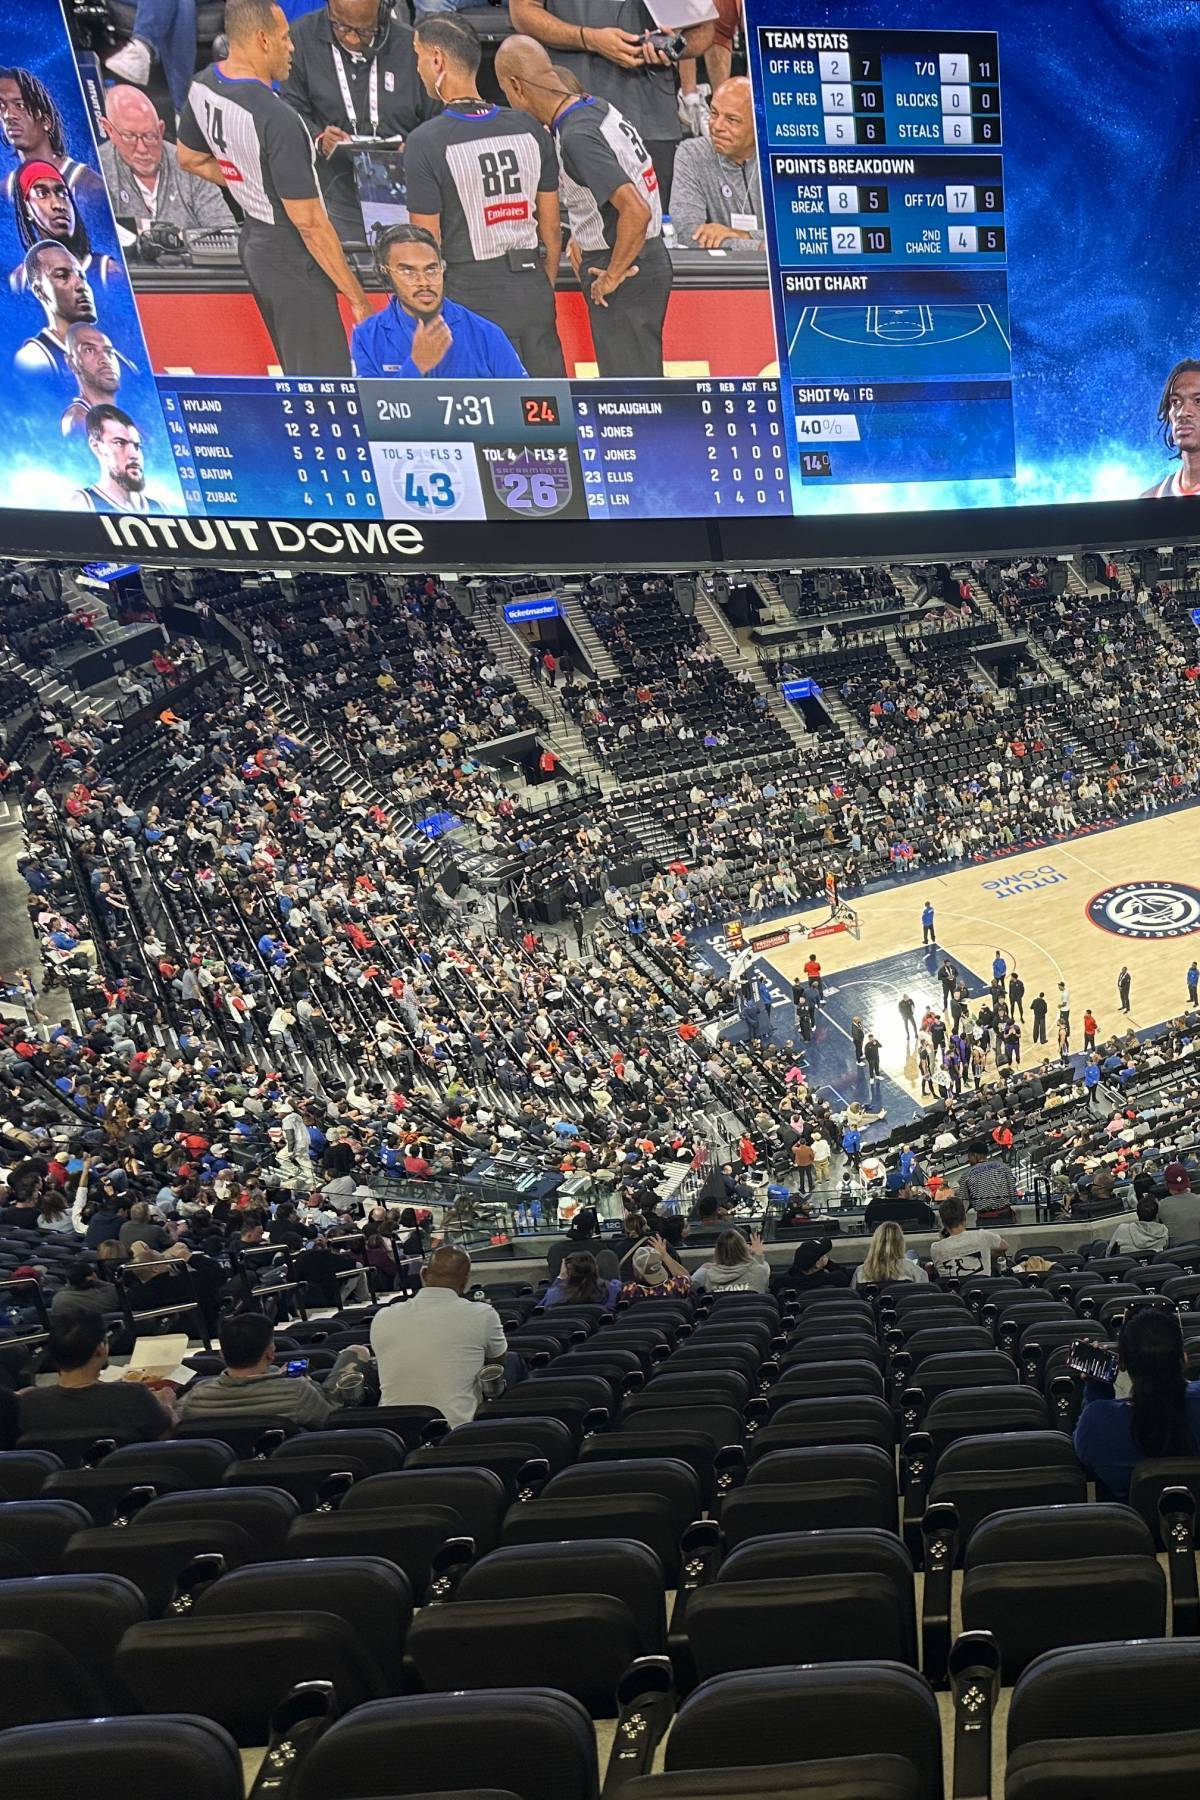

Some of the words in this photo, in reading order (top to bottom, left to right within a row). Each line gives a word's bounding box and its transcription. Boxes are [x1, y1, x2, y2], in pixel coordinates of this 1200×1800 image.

[765, 32, 804, 48] TEAM
[807, 34, 848, 49] STATS
[770, 60, 790, 74] OFF
[794, 60, 814, 75] REB
[831, 61, 839, 75] 2
[862, 61, 870, 75] 7
[915, 62, 935, 76] T/O
[950, 62, 958, 76] 7
[979, 63, 990, 77] 11
[772, 92, 793, 105] DEF
[797, 92, 817, 105] REB
[830, 93, 844, 107] 12
[861, 93, 875, 107] 10
[896, 94, 938, 107] BLOCKS
[952, 94, 959, 108] 0
[982, 94, 990, 108] 0
[776, 124, 819, 137] ASSISTS
[836, 124, 844, 138] 5
[866, 124, 875, 139] 6
[899, 125, 939, 138] STEALS
[954, 125, 961, 138] 6
[983, 124, 992, 139] 6
[478, 150, 522, 197] 82
[776, 160, 825, 173] POINTS
[829, 160, 914, 174] BREAKDOWN
[798, 186, 822, 198] FAST
[839, 192, 848, 208] 8
[869, 192, 878, 209] 5
[905, 194, 925, 207] OFF
[925, 195, 944, 207] T/O
[953, 192, 967, 208] 17
[985, 192, 995, 209] 9
[488, 206, 524, 220] Emirates
[792, 202, 824, 214] BREAK
[796, 228, 807, 240] IN
[811, 228, 827, 240] THE
[837, 233, 855, 249] 22
[867, 233, 884, 249] 10
[923, 231, 941, 241] 2ND
[959, 232, 967, 248] 4
[987, 232, 996, 248] 5
[800, 242, 828, 255] PAINT
[906, 242, 941, 253] CHANCE
[786, 276, 821, 290] SHOT
[824, 276, 868, 290] CHART
[276, 382, 290, 392] PTS
[298, 383, 313, 392] REB
[321, 383, 334, 393] AST
[341, 384, 355, 393] FLS
[697, 383, 711, 393] PTS
[720, 383, 734, 392] REB
[742, 382, 756, 392] AST
[763, 382, 777, 391] FLS
[799, 389, 831, 402] SHOT
[833, 389, 849, 402] %
[859, 388, 873, 400] FG
[166, 399, 175, 411] 5
[184, 400, 221, 412] HYLAND
[282, 401, 293, 413] 2
[305, 401, 314, 414] 3
[328, 401, 335, 414] 1
[347, 401, 357, 414] 0
[377, 400, 411, 421] 2ND
[437, 396, 495, 426] 7:31
[525, 401, 554, 422] 24
[578, 403, 587, 415] 3
[598, 403, 662, 415] MCLAUGHLIN
[169, 422, 182, 433] 14
[189, 423, 218, 434] MANN
[285, 424, 300, 436] 12
[310, 424, 320, 436] 2
[332, 424, 341, 437] 0
[353, 424, 360, 437] 1
[579, 426, 593, 438] 15
[601, 427, 633, 438] JONES
[801, 420, 842, 434] 40%
[174, 445, 189, 456] 24
[195, 447, 233, 458] POWELL
[293, 447, 302, 459] 5
[315, 447, 325, 460] 2
[337, 448, 346, 460] 0
[357, 448, 366, 460] 2
[382, 449, 402, 459] TOL
[406, 450, 414, 460] 5
[431, 449, 450, 460] FLS
[455, 450, 462, 460] 3
[482, 449, 502, 461] TOL
[507, 448, 516, 460] 4
[534, 449, 555, 461] FLS
[558, 449, 568, 461] 2
[583, 450, 596, 461] 17
[604, 450, 637, 460] JONES
[180, 468, 195, 479] 33
[200, 469, 232, 480] BATUM
[585, 472, 601, 483] 23
[608, 472, 633, 483] ELLIS
[185, 490, 199, 501] 40
[206, 491, 237, 503] ZUBAC
[405, 472, 456, 508] 43
[504, 474, 558, 508] 26
[589, 494, 604, 505] 25
[611, 494, 629, 505] LEN
[100, 516, 259, 551] INTUIT
[268, 521, 424, 554] DOME
[508, 606, 554, 618] ticketmaster
[1092, 882, 1172, 911] CLIPPERS
[606, 1222, 620, 1230] 12C
